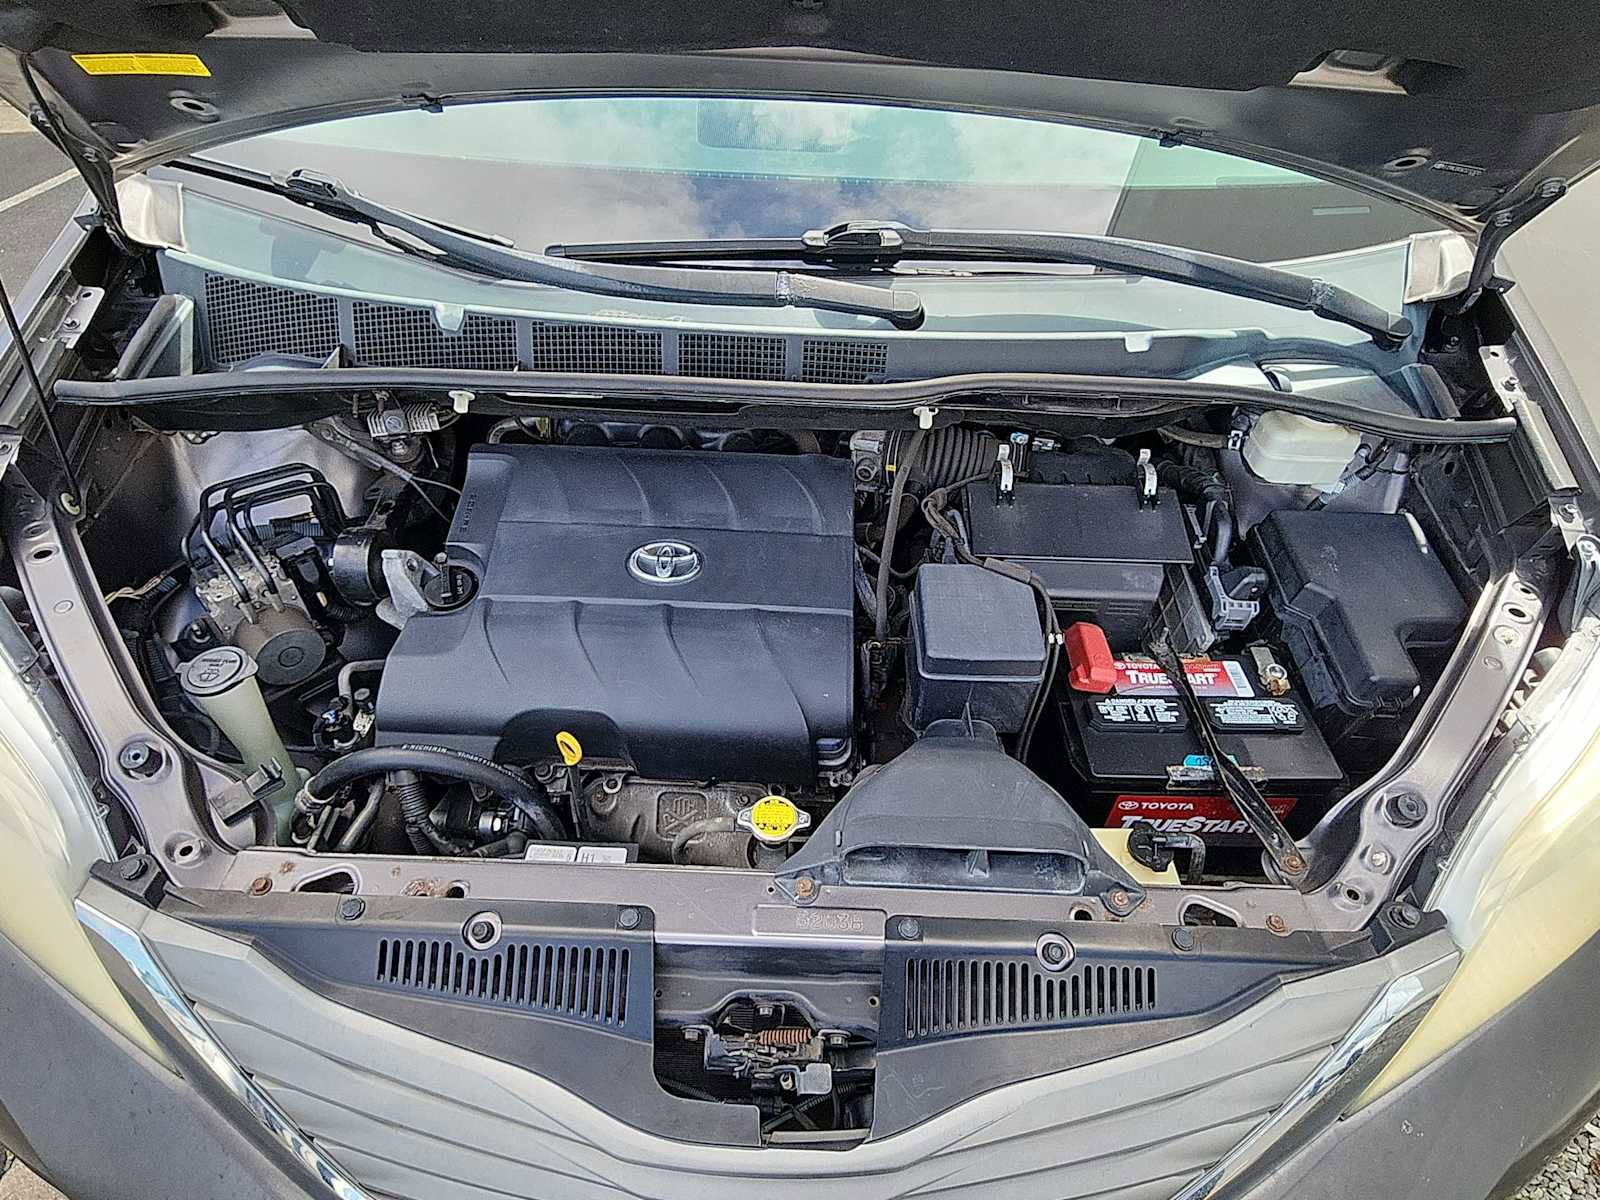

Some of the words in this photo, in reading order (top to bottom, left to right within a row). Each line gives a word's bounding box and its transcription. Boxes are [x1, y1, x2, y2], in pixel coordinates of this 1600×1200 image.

[1125, 661, 1160, 669] TOYOTA
[1126, 670, 1215, 684] TRUEART
[1141, 802, 1194, 811] TOYOTA
